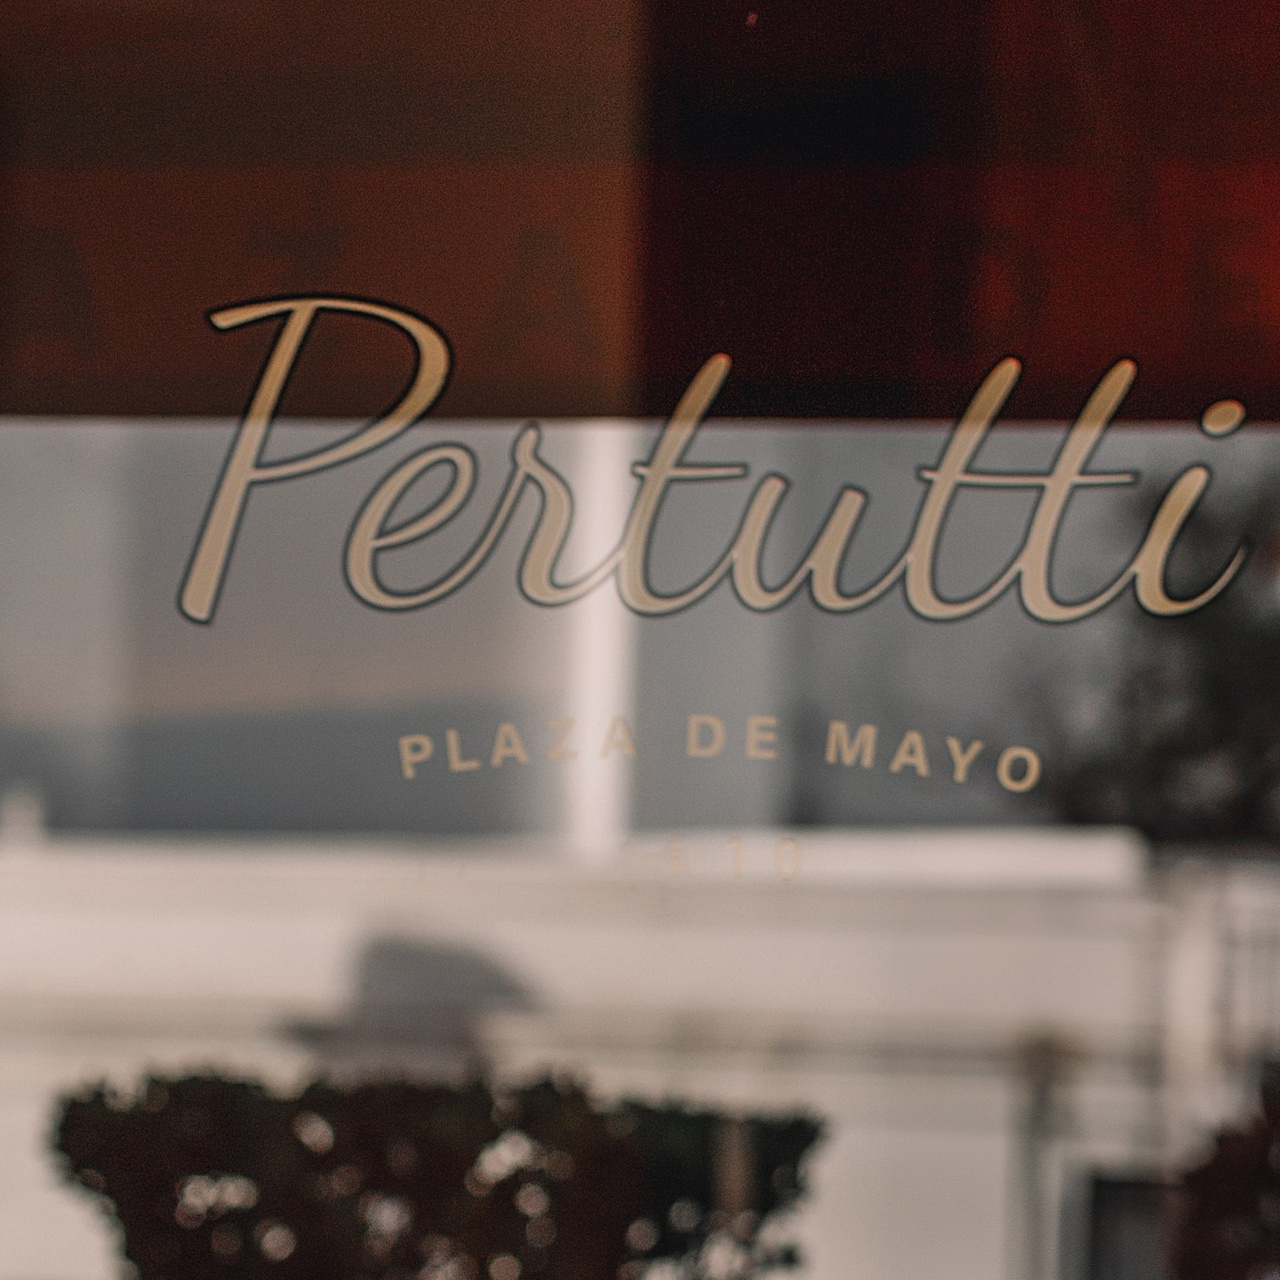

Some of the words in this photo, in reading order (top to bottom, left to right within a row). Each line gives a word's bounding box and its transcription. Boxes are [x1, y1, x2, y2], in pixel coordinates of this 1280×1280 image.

[178, 294, 1251, 624] Pertutti
[398, 714, 639, 780] PLAZA
[686, 713, 780, 761] DE
[823, 719, 1043, 794] MAYO
